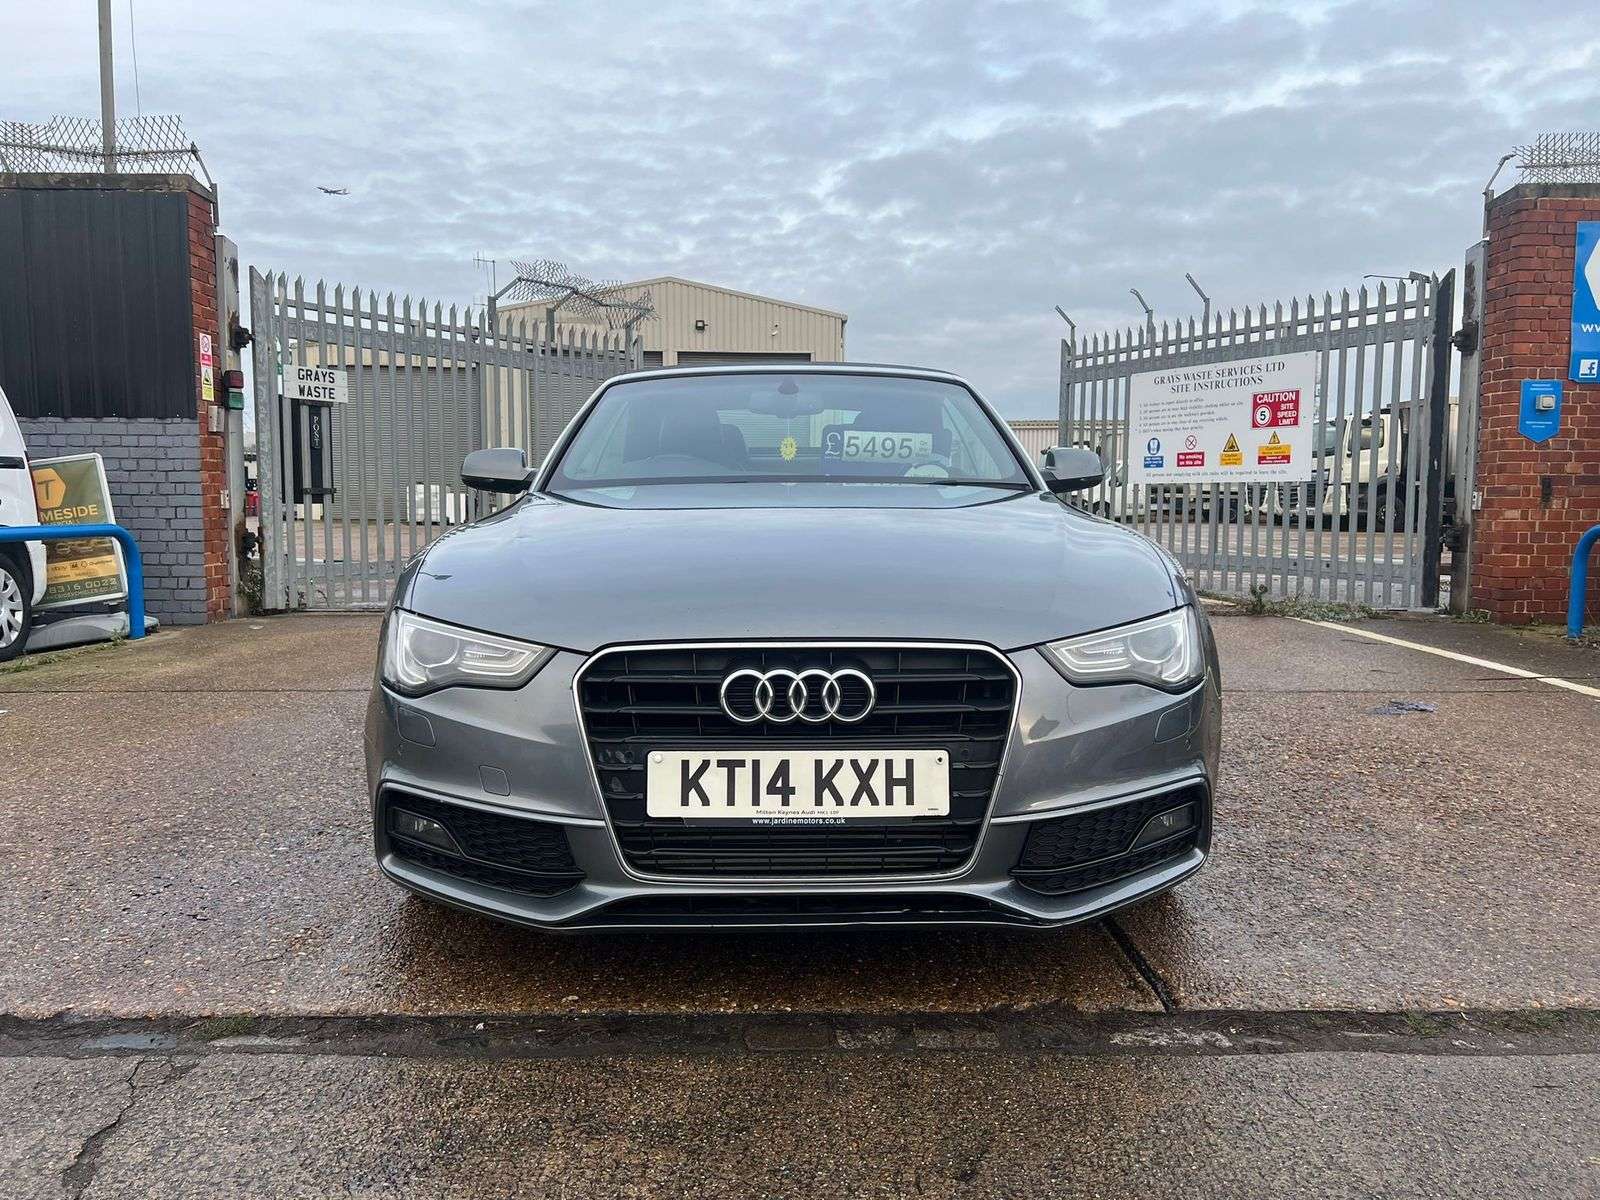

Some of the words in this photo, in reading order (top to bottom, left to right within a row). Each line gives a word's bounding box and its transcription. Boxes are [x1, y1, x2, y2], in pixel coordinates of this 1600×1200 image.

[298, 368, 335, 384] GRAYS
[1153, 374, 1181, 386] GRAYS
[1183, 369, 1213, 382] WASTE
[1215, 363, 1262, 379] SERVICES
[1266, 361, 1285, 373] LTD
[1171, 383, 1193, 394] SITE
[1194, 375, 1263, 392] INSTRUCTIONS
[298, 385, 336, 400] WASTE
[1256, 391, 1296, 403] CAUTION
[1280, 402, 1295, 410] SITE
[1260, 410, 1266, 421] 5
[1277, 410, 1298, 419] SPEED
[1278, 418, 1295, 426] LIMIT
[680, 759, 796, 807] KT14
[814, 758, 915, 807] KXH
